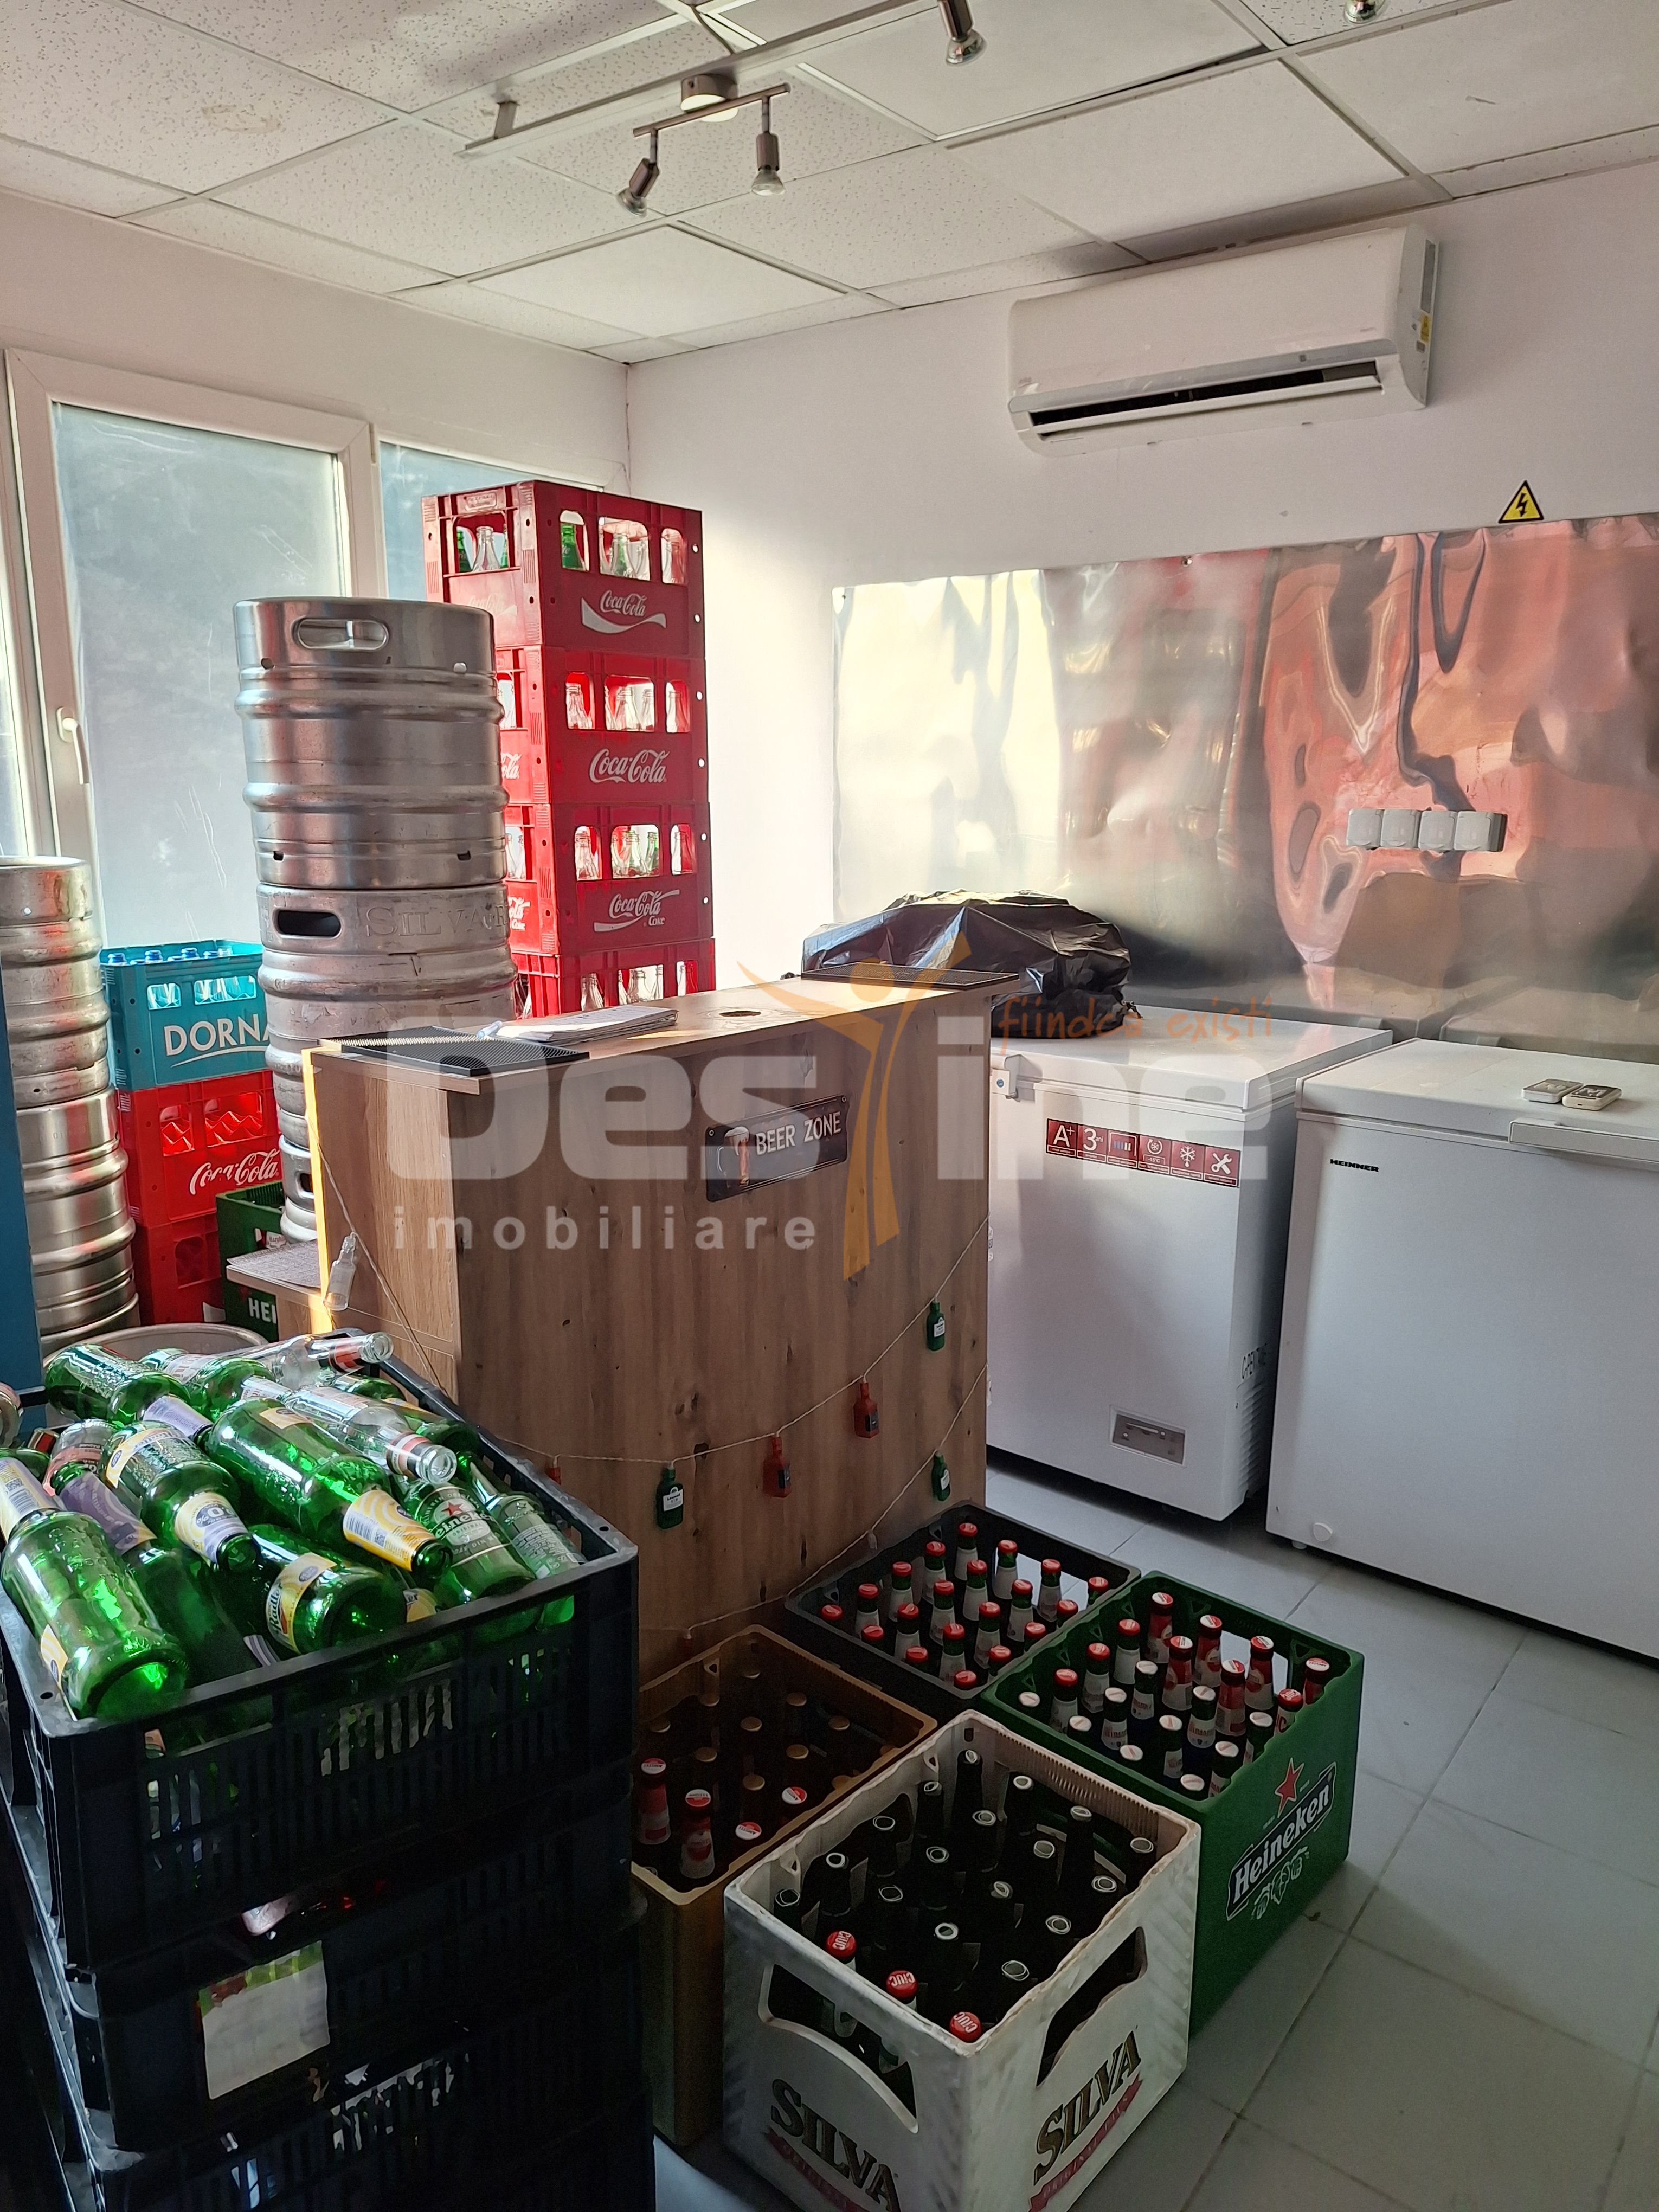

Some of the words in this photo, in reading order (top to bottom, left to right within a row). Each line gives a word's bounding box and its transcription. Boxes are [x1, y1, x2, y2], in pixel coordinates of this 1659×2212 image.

[589, 748, 670, 783] Coca-Cola
[164, 1013, 269, 1056] DORN
[756, 1124, 796, 1155] BEER
[804, 1111, 841, 1142] ZONE
[1053, 1125, 1075, 1147] A+
[1083, 1128, 1097, 1151] 3
[1329, 1159, 1379, 1172] HEINNER
[1232, 1784, 1330, 1905] Heineken
[1033, 2030, 1142, 2187] SILVA
[770, 2079, 901, 2212] SILVA
